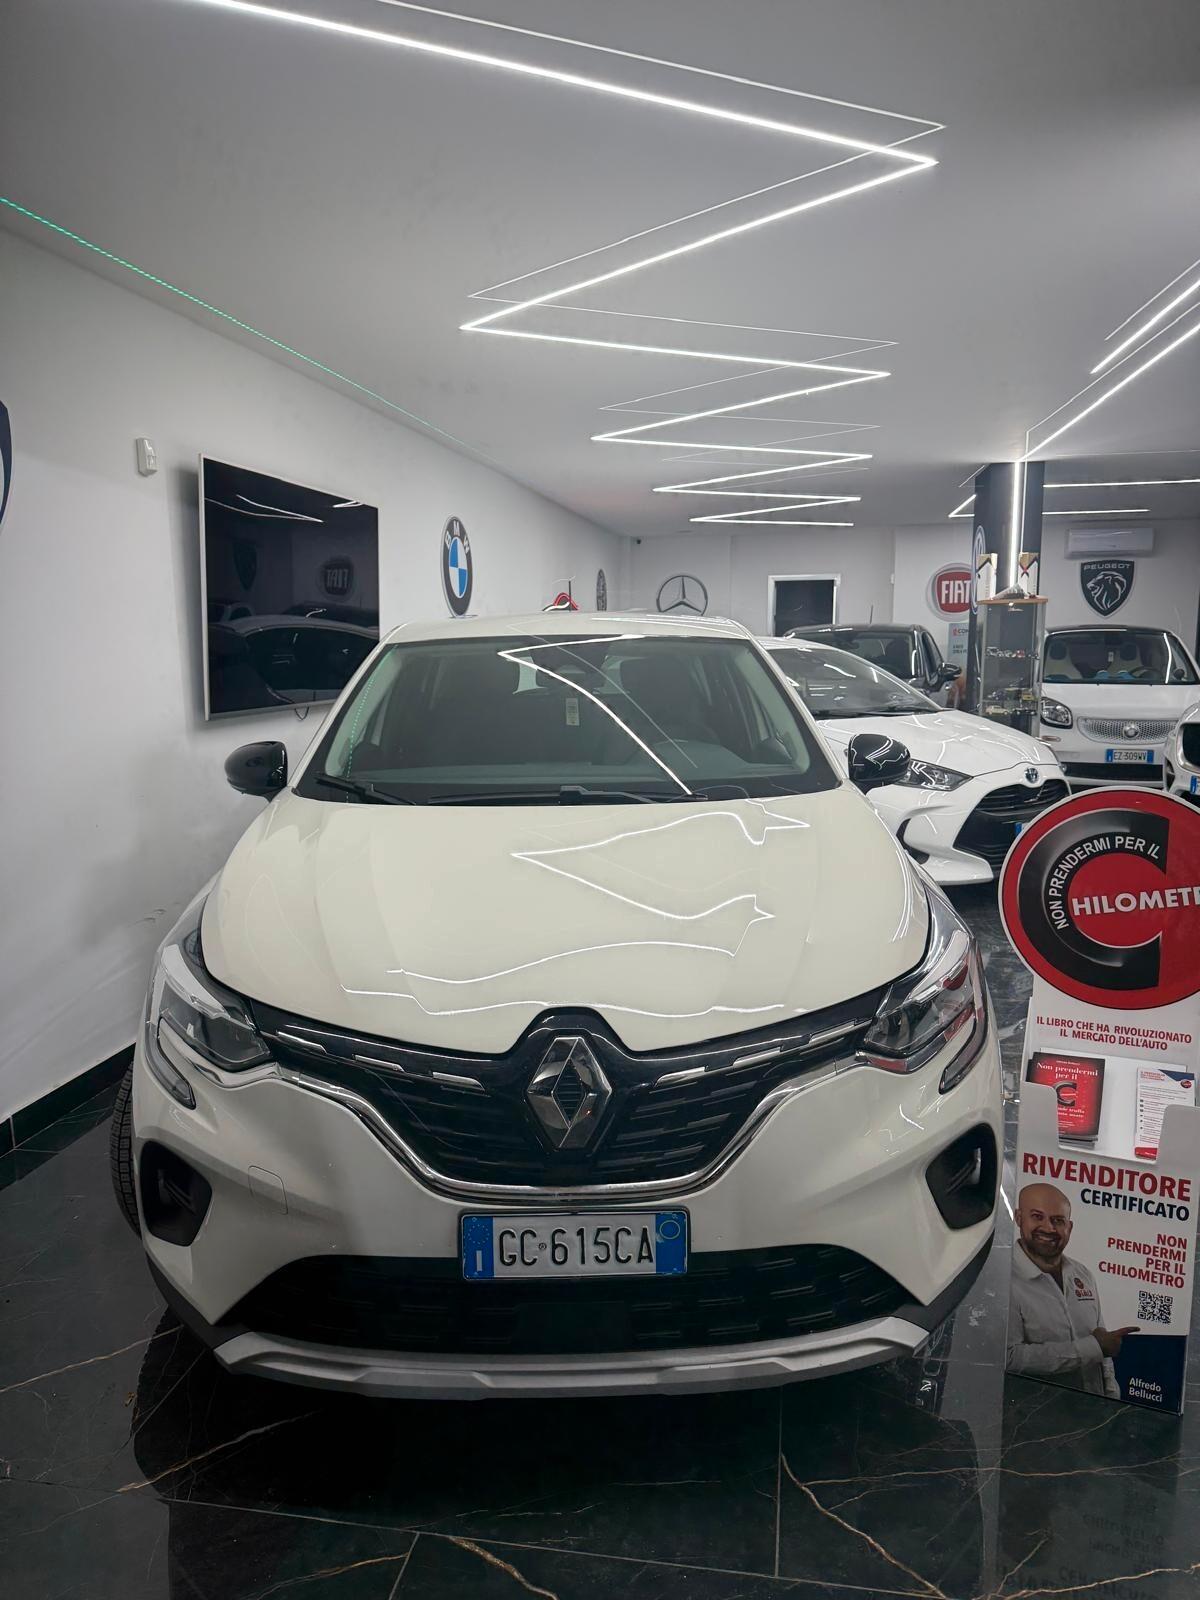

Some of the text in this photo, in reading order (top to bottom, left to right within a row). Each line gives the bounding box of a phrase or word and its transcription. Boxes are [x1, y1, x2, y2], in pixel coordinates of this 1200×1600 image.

[445, 520, 471, 554] BMW
[941, 580, 971, 604] FIAT
[1049, 836, 1160, 930] NON PRENDERMI PER IL
[1036, 1016, 1192, 1044] IL LIBRO CHE HA RIVOLUZIONATO
[1060, 1028, 1168, 1051] IL MERCATO DELL'AUTO
[1037, 1062, 1053, 1070] Non
[1055, 1066, 1098, 1077] prendermi
[1023, 1152, 1192, 1202] RIVENDITORE
[1080, 1188, 1190, 1221] CERTIFICATO
[1107, 1237, 1187, 1263] PRENDERMI
[1156, 1233, 1188, 1249] NON
[1098, 1261, 1185, 1289] CHILOMETRO
[1145, 1257, 1187, 1276] PER IL
[1128, 1376, 1162, 1393] Alfredo
[1128, 1386, 1163, 1404] Bellucci
